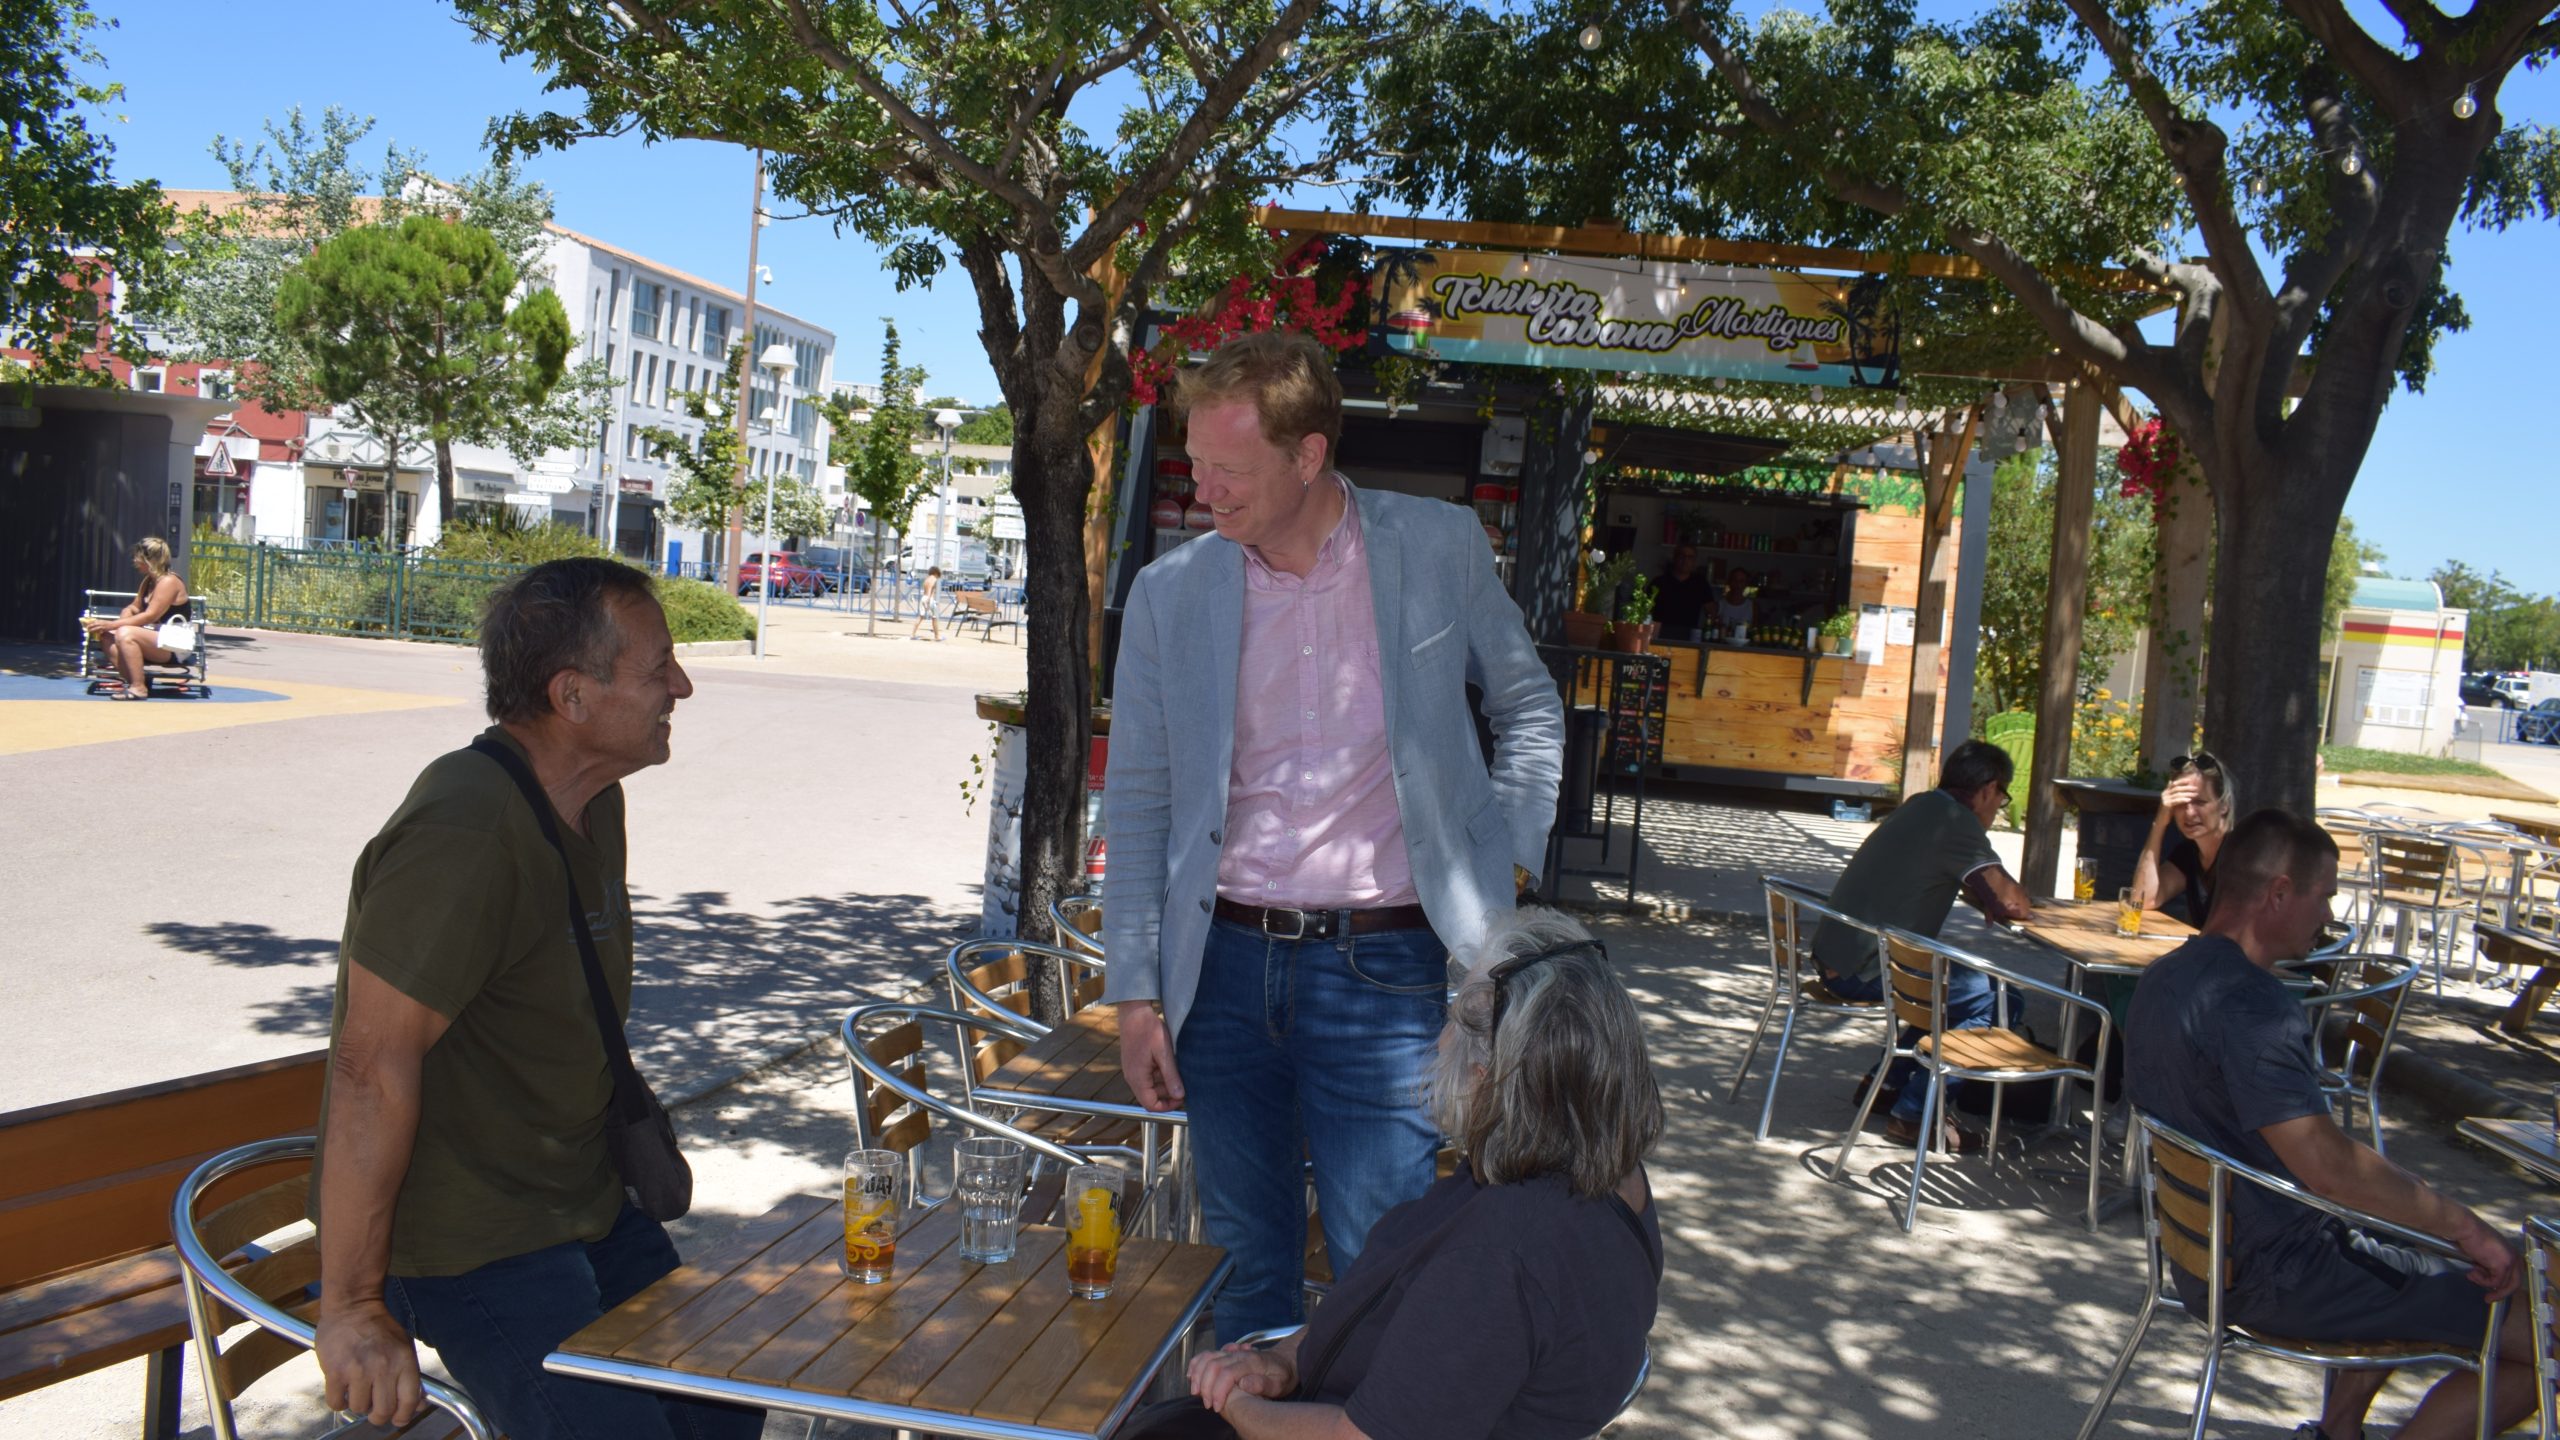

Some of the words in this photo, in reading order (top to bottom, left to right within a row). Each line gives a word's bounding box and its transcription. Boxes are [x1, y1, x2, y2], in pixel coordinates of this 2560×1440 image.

[1432, 272, 1602, 321] Tchikita
[1526, 308, 1681, 352] Cabana
[1682, 297, 1843, 350] Martigues
